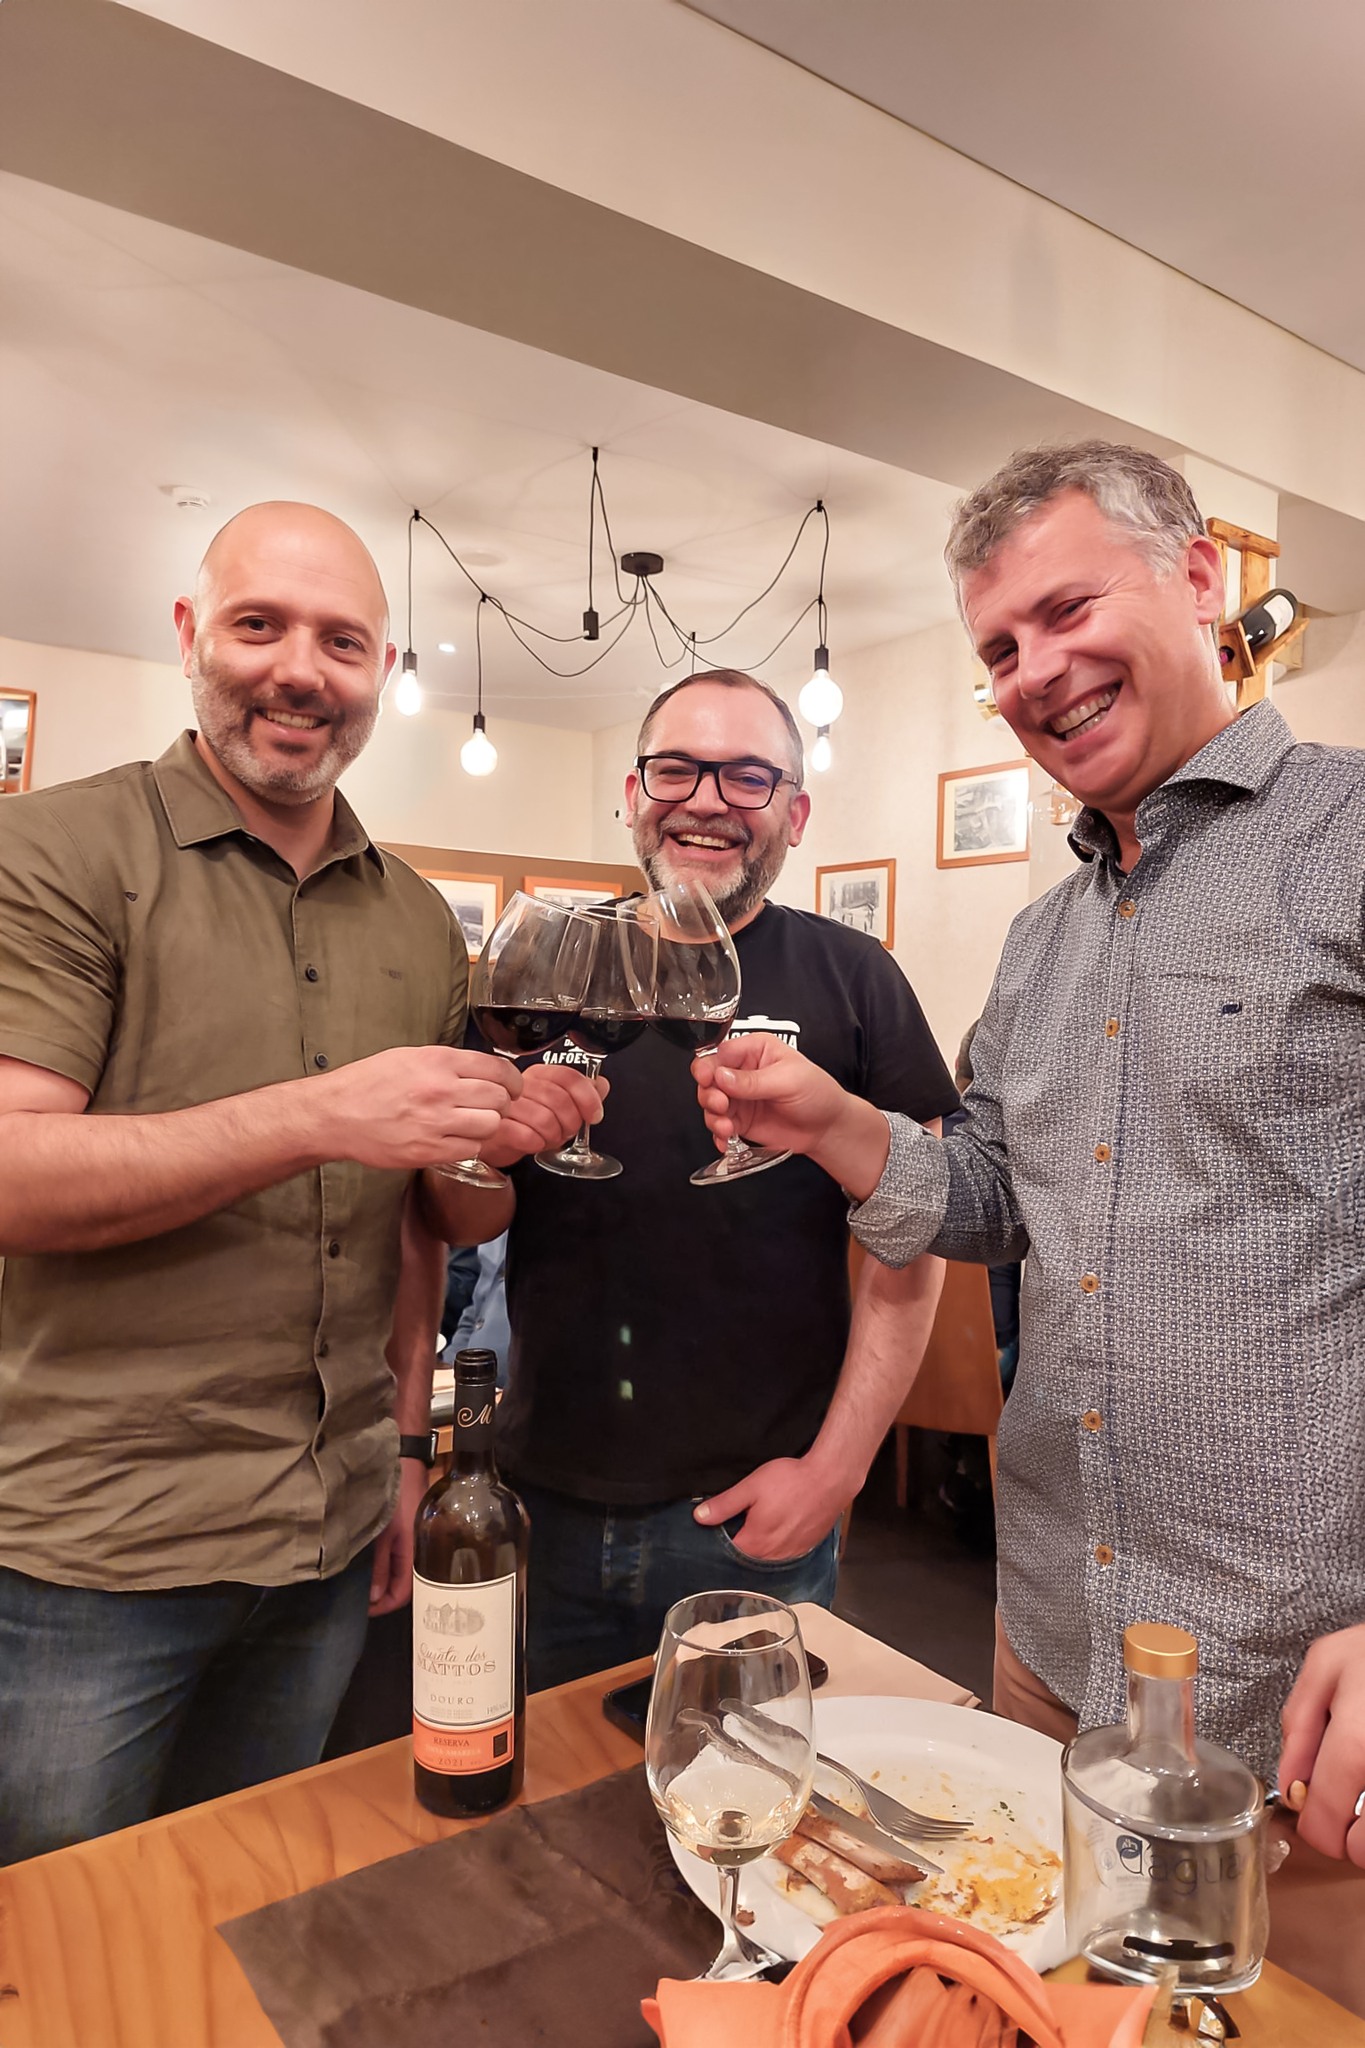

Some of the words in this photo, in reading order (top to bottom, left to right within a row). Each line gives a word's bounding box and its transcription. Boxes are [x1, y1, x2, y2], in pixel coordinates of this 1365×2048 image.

[465, 1643, 487, 1662] dos
[416, 1652, 496, 1677] MATTOS
[430, 1694, 475, 1705] DOURO
[433, 1737, 470, 1747] RESERVA
